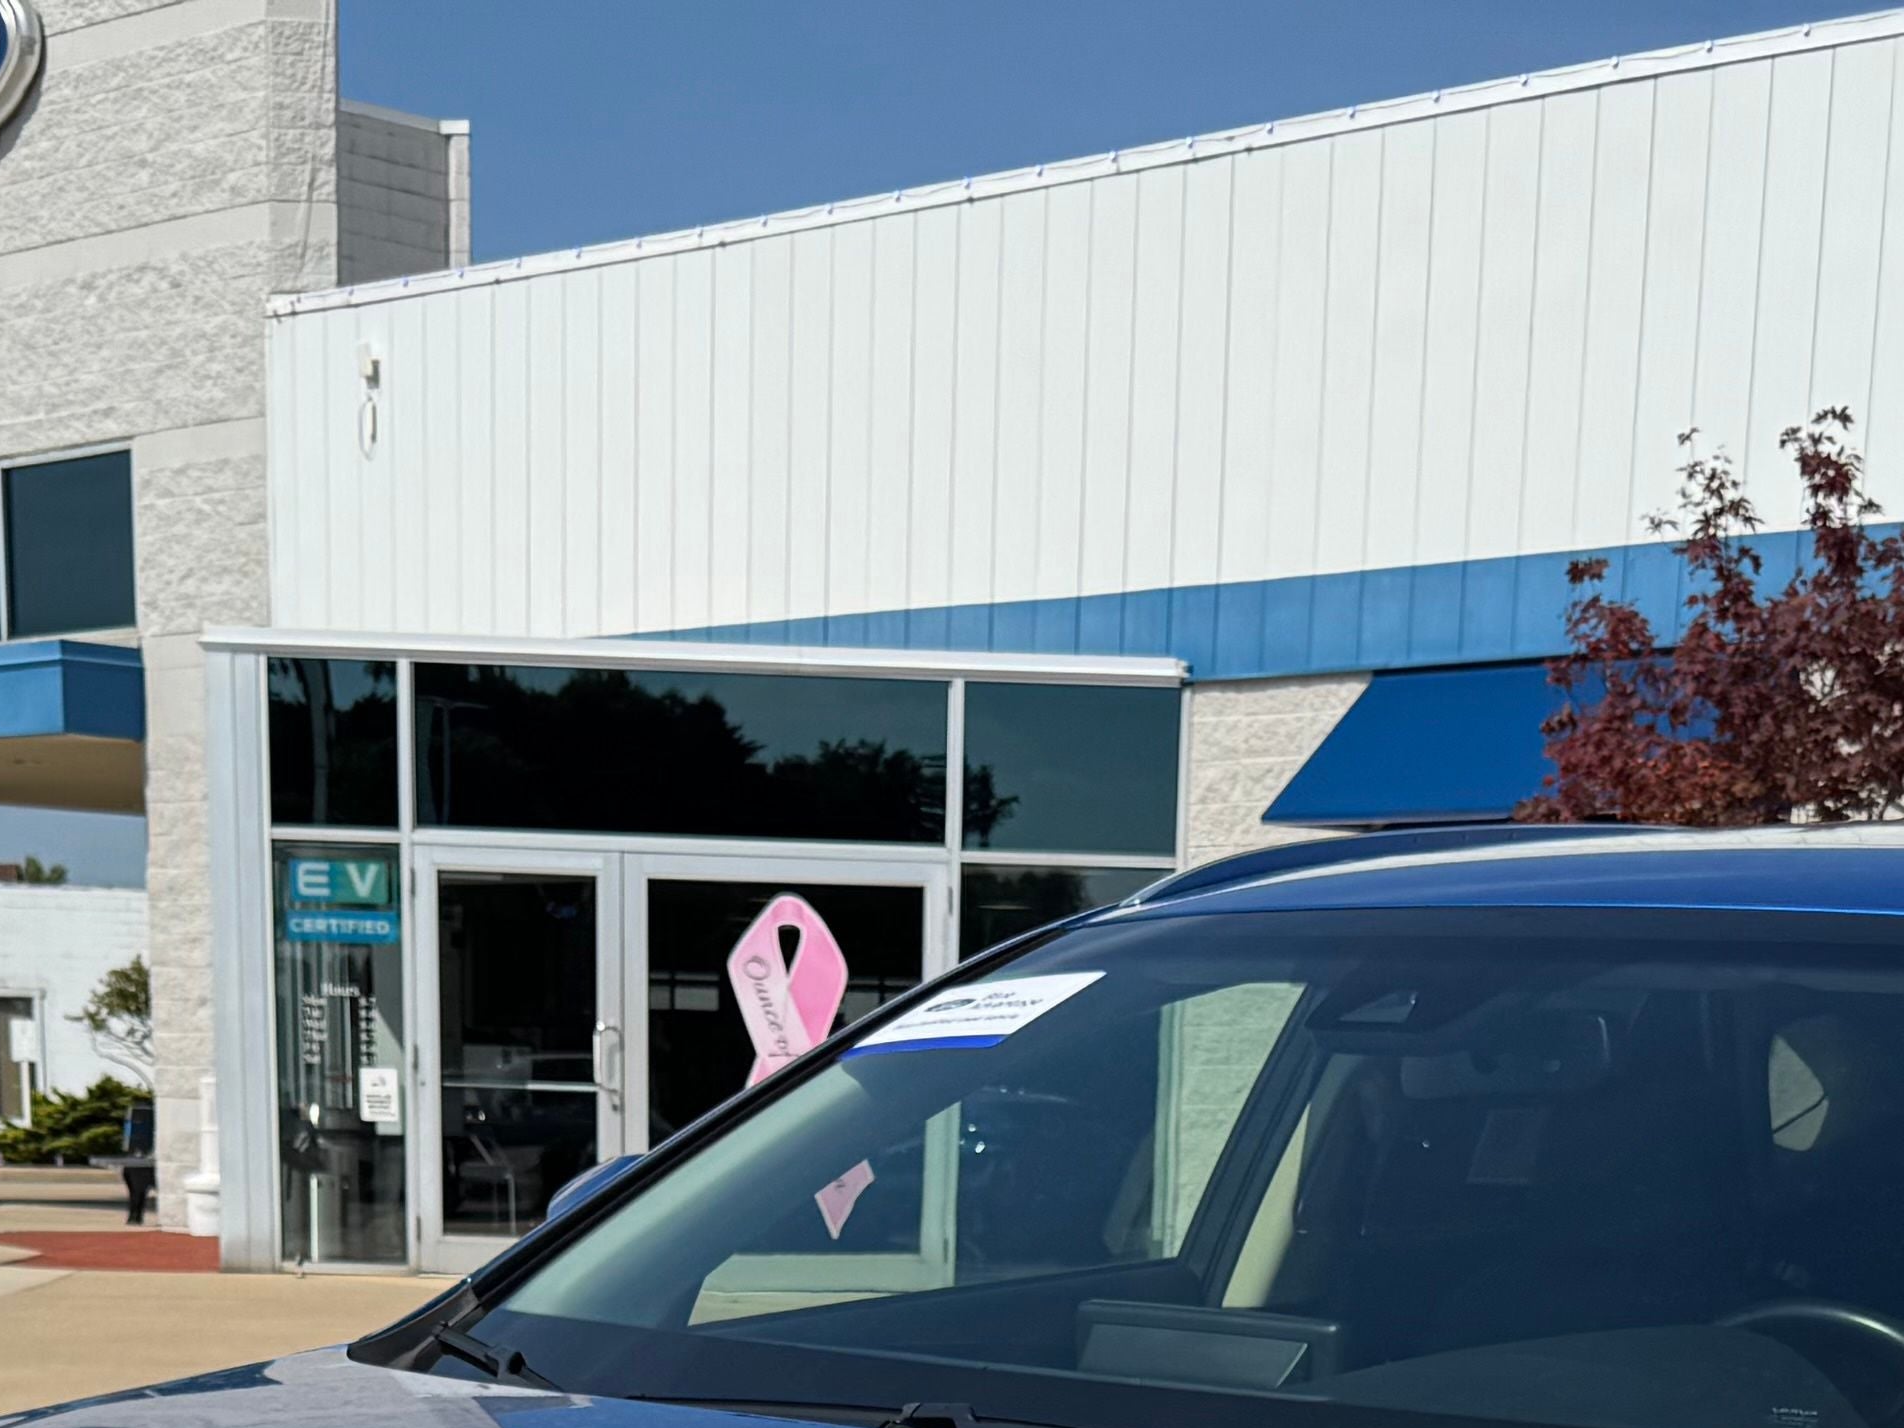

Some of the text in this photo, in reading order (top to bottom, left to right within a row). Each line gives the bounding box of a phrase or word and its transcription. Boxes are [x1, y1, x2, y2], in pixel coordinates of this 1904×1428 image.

[296, 861, 380, 898] EV
[289, 918, 390, 935] CERTIFIED
[742, 954, 784, 1034] Ounce
